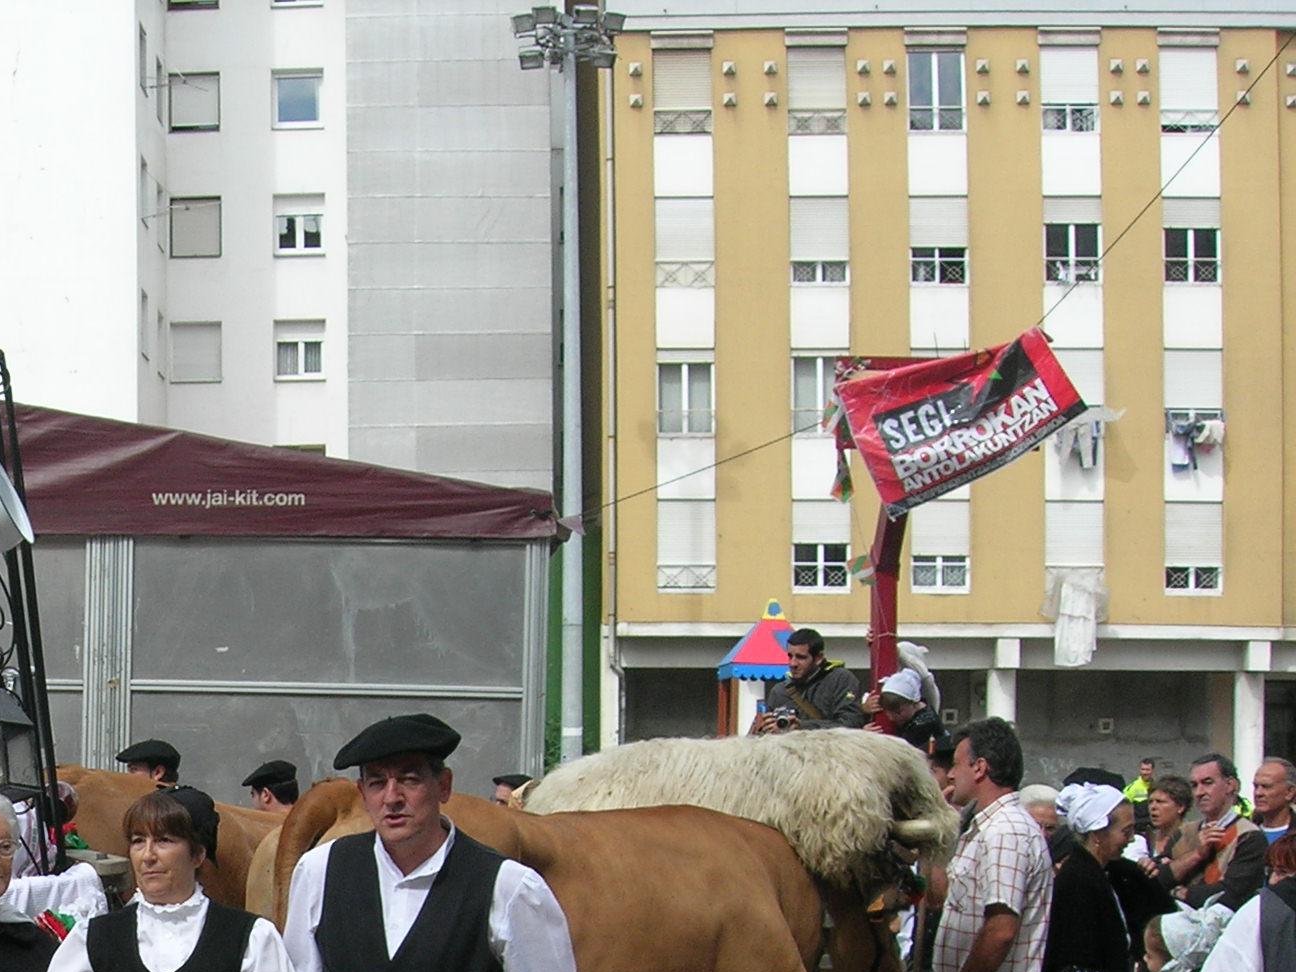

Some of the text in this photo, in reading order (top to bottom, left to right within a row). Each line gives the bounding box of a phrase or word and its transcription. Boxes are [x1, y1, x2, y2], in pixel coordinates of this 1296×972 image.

[891, 377, 1051, 480] BORROKAN
[904, 396, 1059, 493] ANTOLAKUNTZAN
[152, 489, 305, 509] www.jai-kit.com
